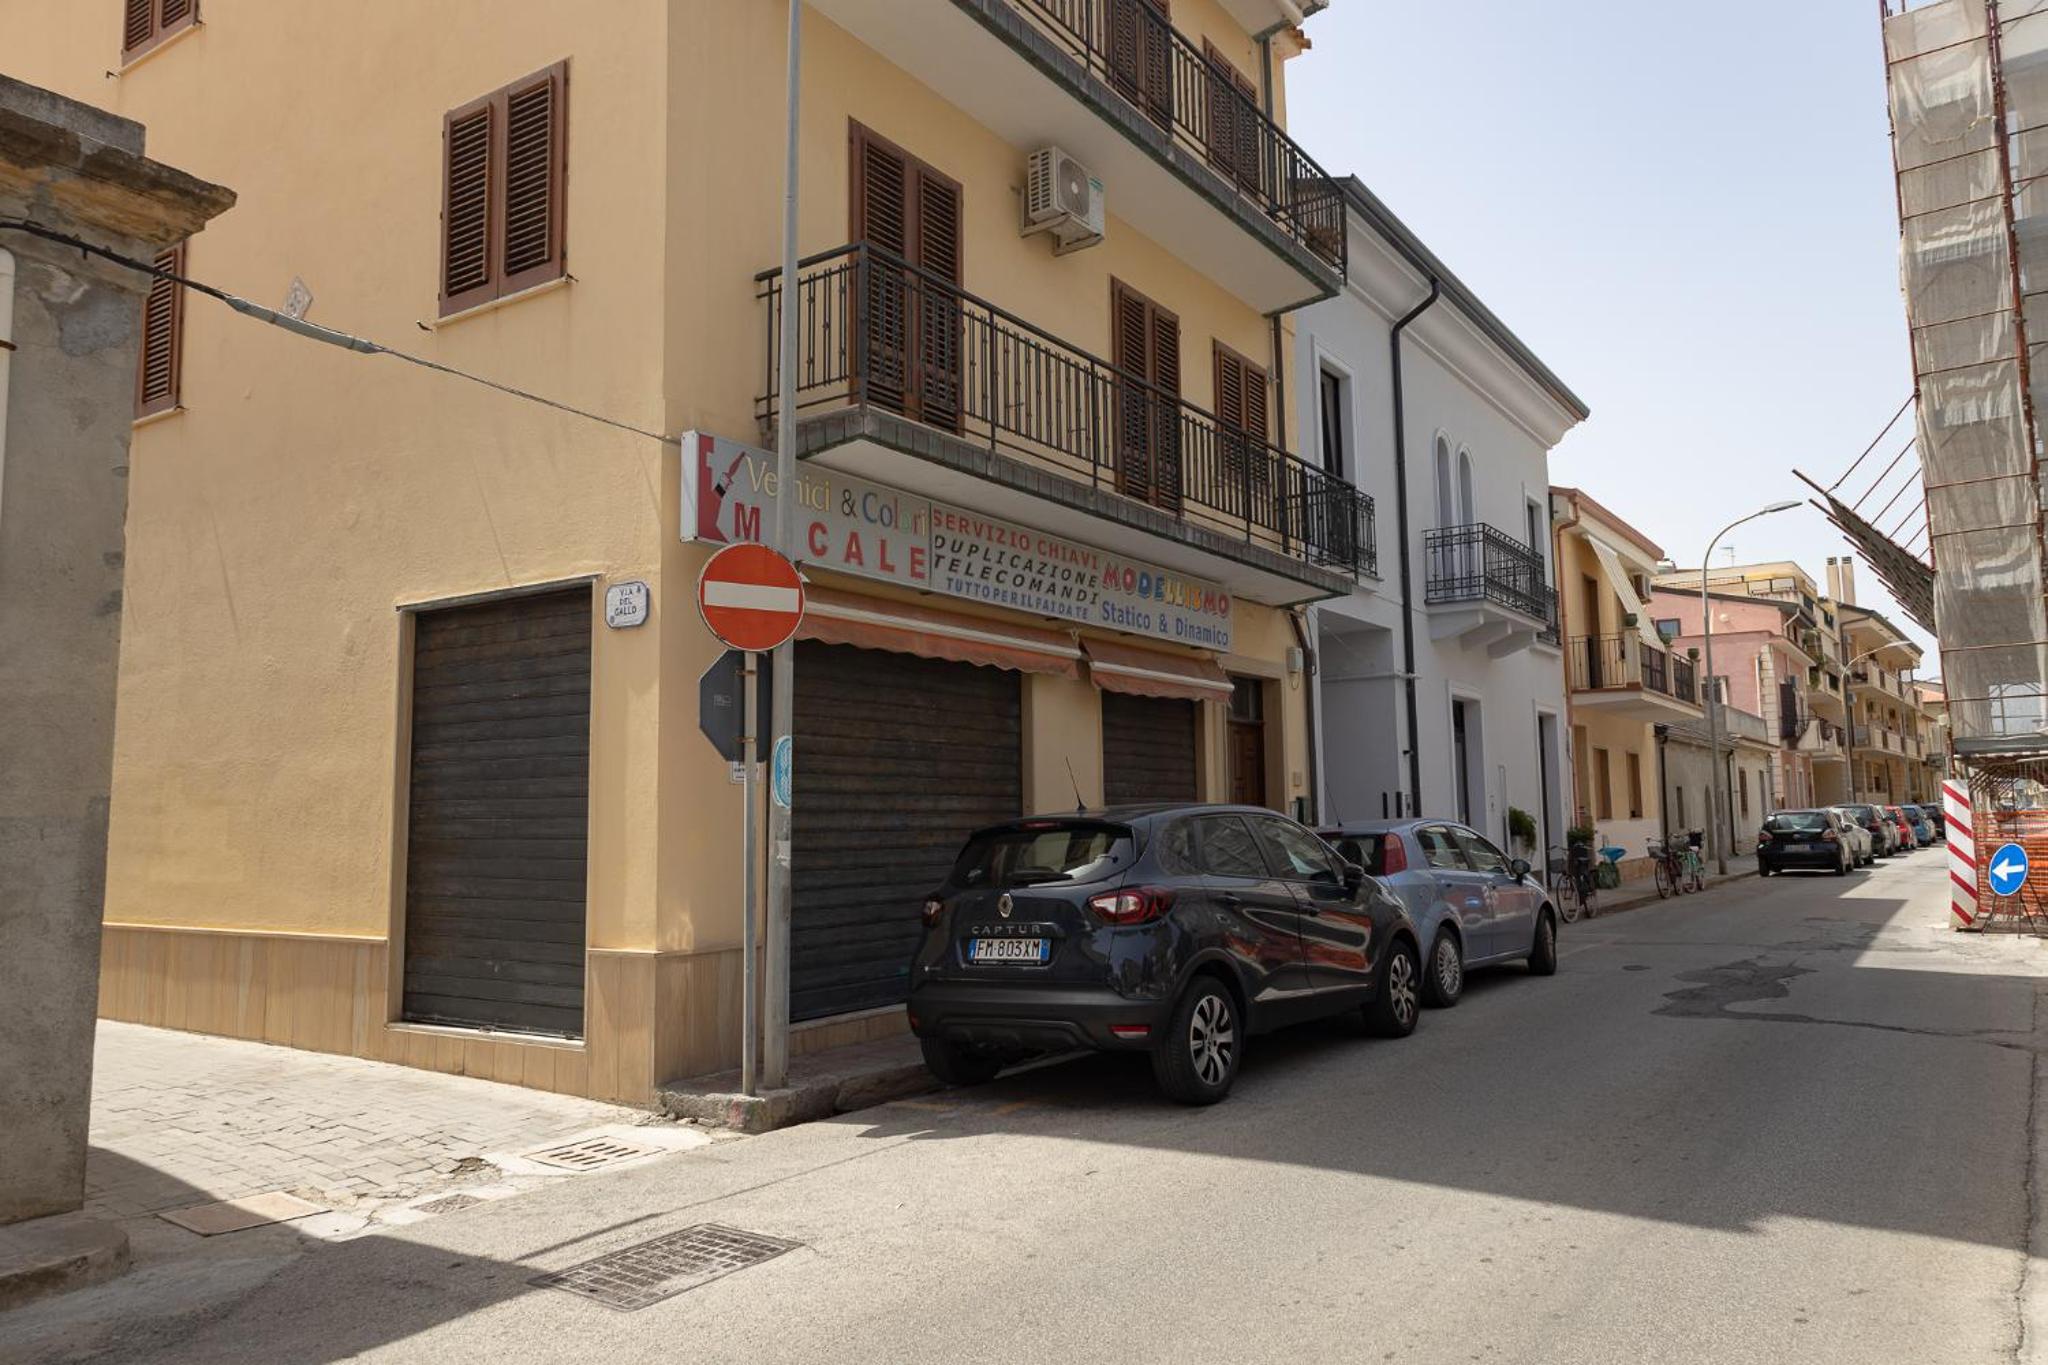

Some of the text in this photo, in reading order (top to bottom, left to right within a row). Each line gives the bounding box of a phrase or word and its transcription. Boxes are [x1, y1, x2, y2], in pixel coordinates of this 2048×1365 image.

[745, 456, 926, 537] Venici & Colori
[734, 502, 926, 580] MCALE
[933, 508, 1098, 570] SERVIZIO CHIAVI
[934, 535, 1098, 588] DUPLICAZIONE
[934, 554, 1098, 605] TELECOMANDI
[1102, 562, 1230, 619] MODELLISMO
[1102, 601, 1228, 646] Statico & Dinamico
[971, 925, 1041, 935] CAPTUR
